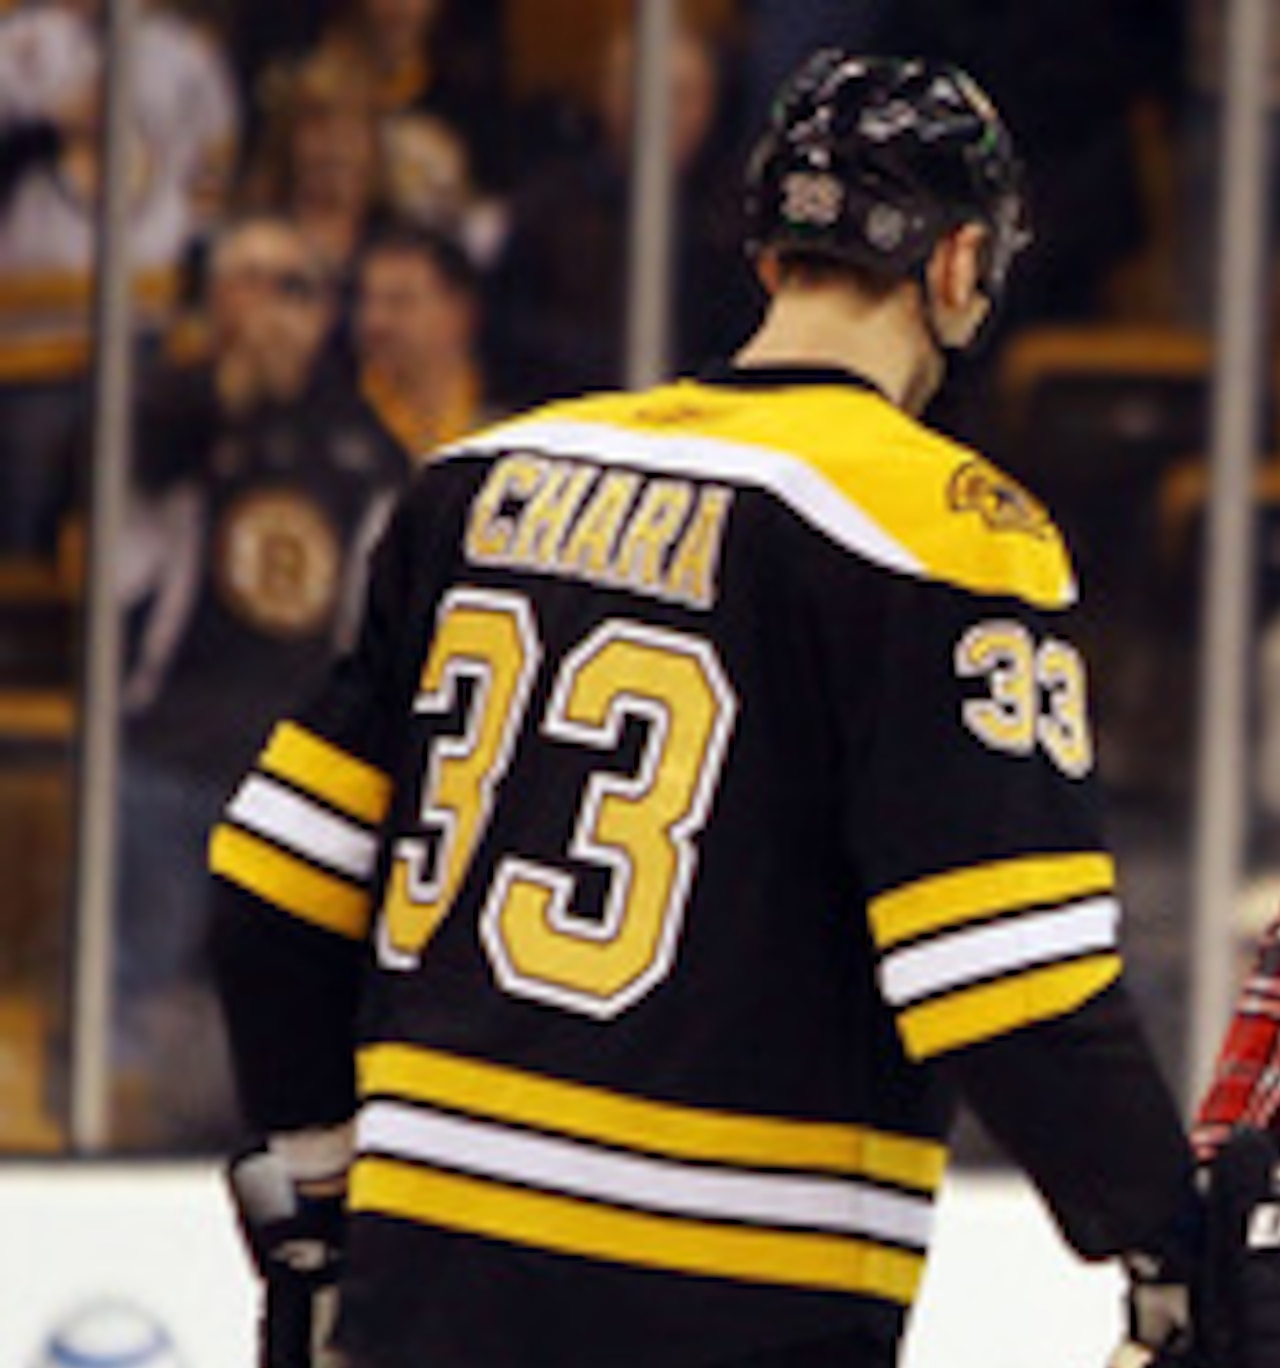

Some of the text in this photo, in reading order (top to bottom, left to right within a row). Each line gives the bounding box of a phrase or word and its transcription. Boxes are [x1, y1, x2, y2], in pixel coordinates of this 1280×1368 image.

[464, 452, 735, 611] CHARA
[953, 617, 1096, 780] 33
[375, 587, 738, 1021] 33
